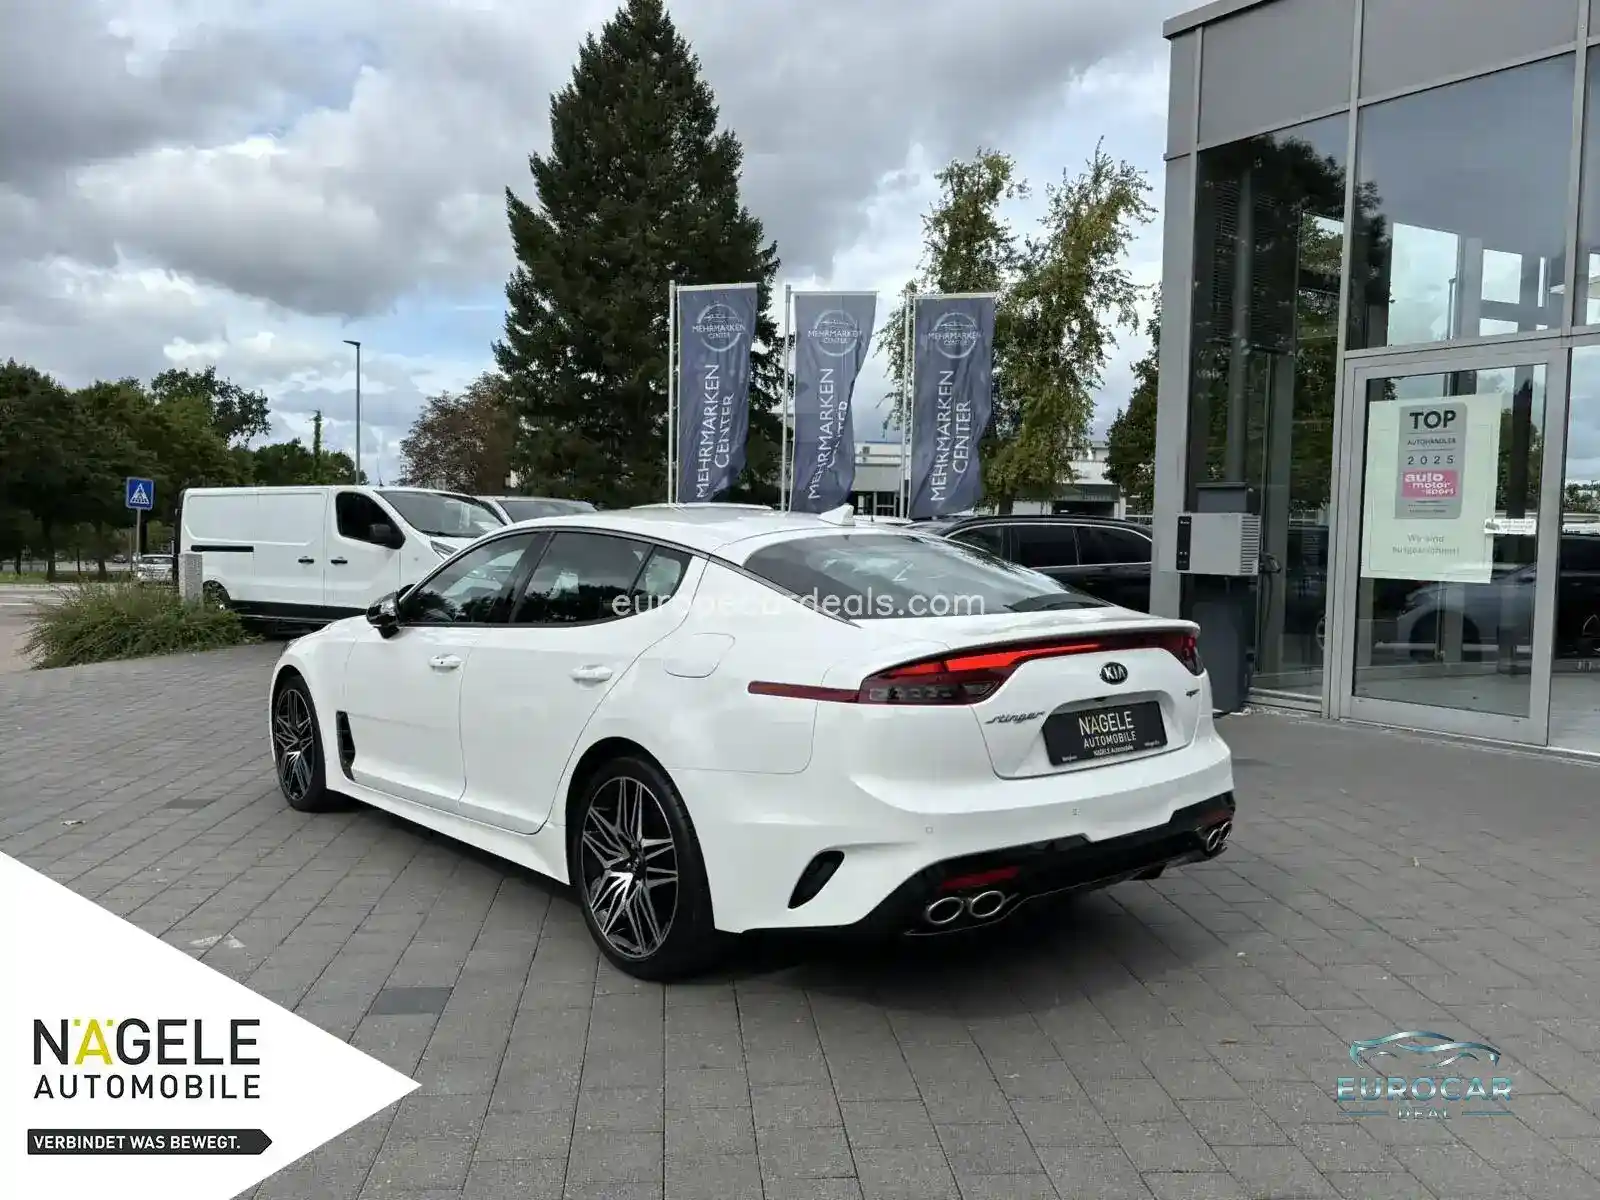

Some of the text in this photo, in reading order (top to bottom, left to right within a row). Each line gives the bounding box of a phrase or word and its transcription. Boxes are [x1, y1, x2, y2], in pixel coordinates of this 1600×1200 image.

[696, 364, 721, 499] MEHRMARKEN
[713, 392, 735, 469] CENTER
[808, 368, 834, 499] MEHRMARKEN
[931, 370, 955, 501] MEHRMARKEN
[952, 399, 972, 474] CENTER
[1409, 410, 1457, 430] TOP
[1404, 472, 1445, 483] auto
[1412, 481, 1452, 489] motor
[1104, 666, 1127, 680] KIA
[1083, 730, 1137, 749] AUTOMOBILE
